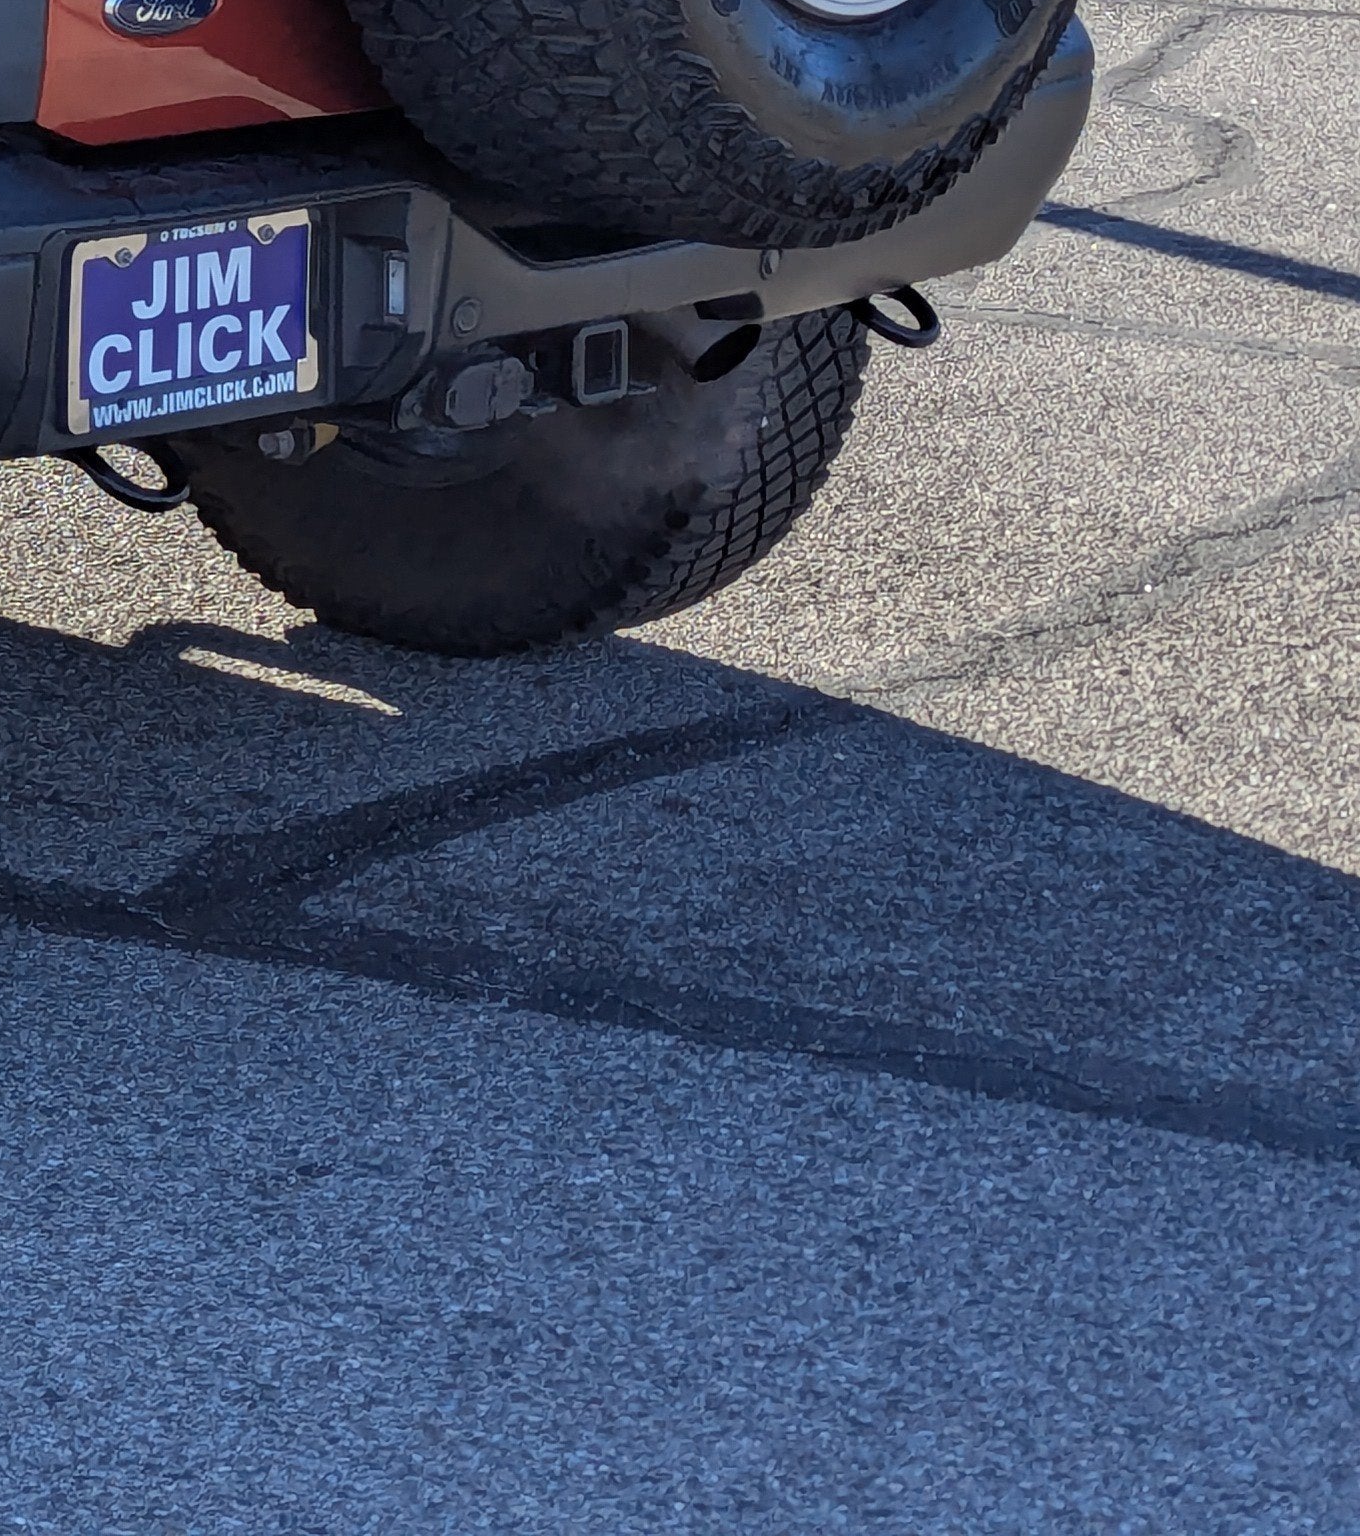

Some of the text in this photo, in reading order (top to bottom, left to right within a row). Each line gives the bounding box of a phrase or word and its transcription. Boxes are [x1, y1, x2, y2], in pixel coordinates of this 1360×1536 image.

[132, 245, 252, 320] JIM
[88, 304, 292, 395] CLICK
[93, 370, 296, 429] WWW.JIMCLICK.COM
